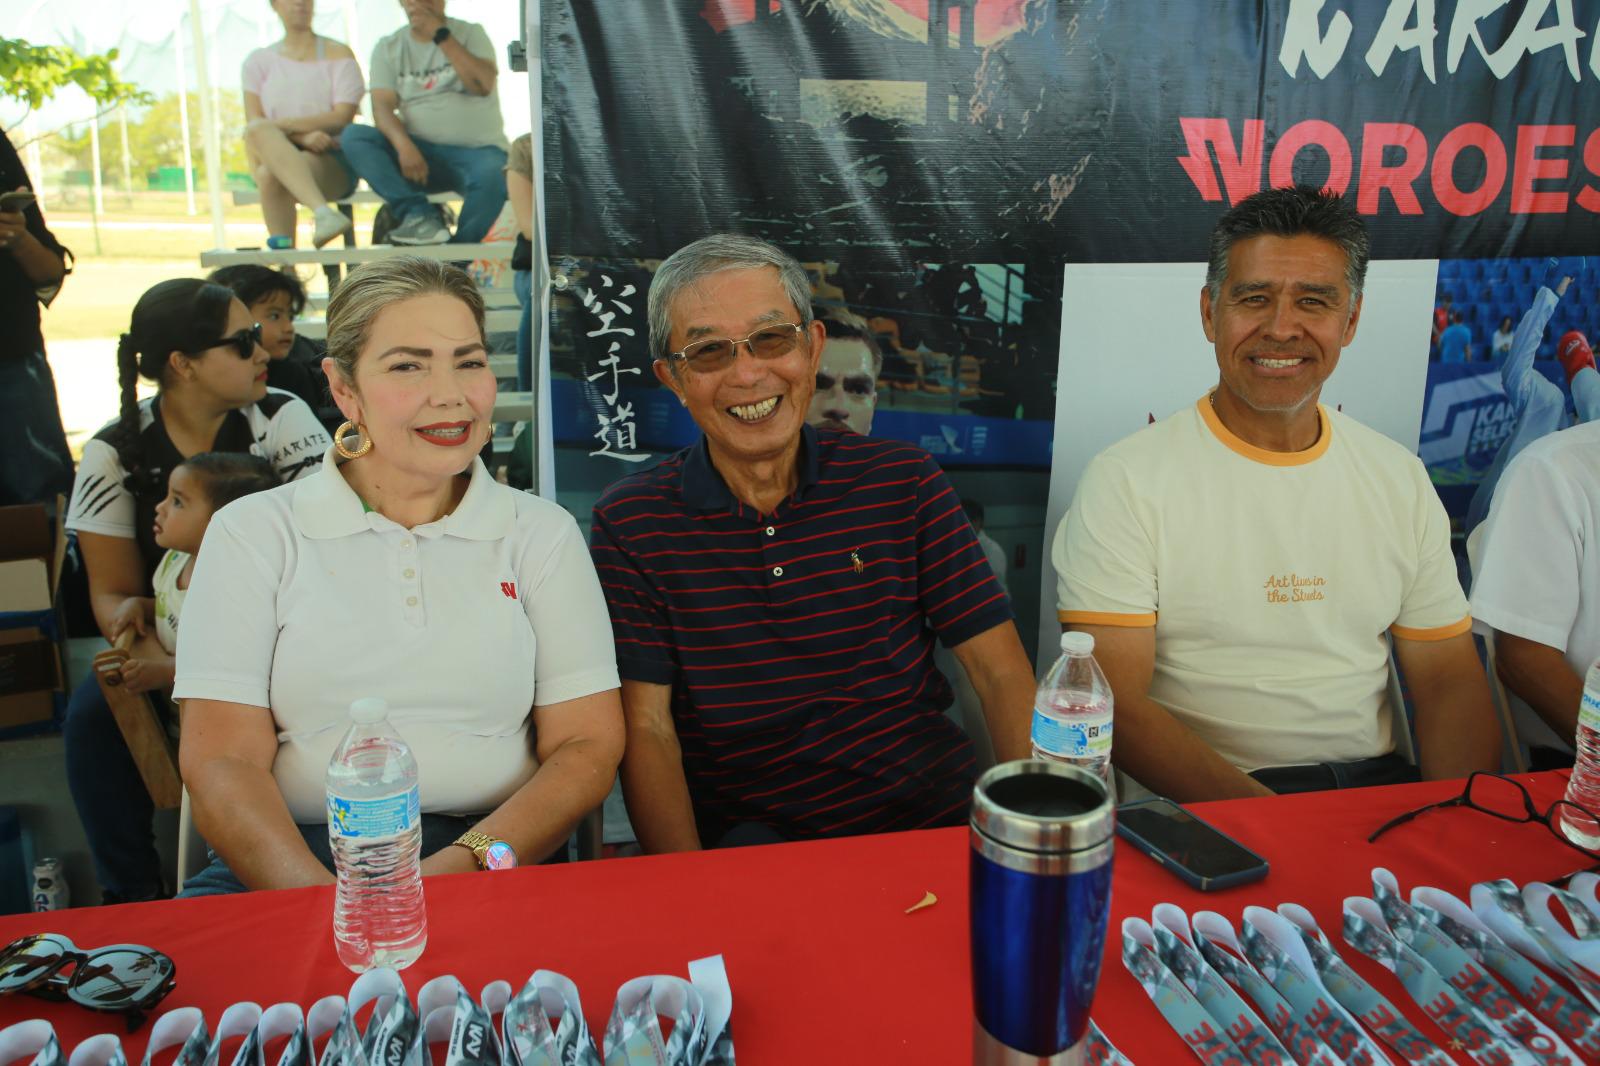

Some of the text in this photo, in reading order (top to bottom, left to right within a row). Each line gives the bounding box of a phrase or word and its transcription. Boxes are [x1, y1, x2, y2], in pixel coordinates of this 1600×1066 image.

[1279, 0, 1600, 84] KARA
[583, 274, 652, 463] 空手道
[273, 433, 327, 462] KARATE
[1264, 575, 1290, 588] Art
[1267, 590, 1289, 603] the
